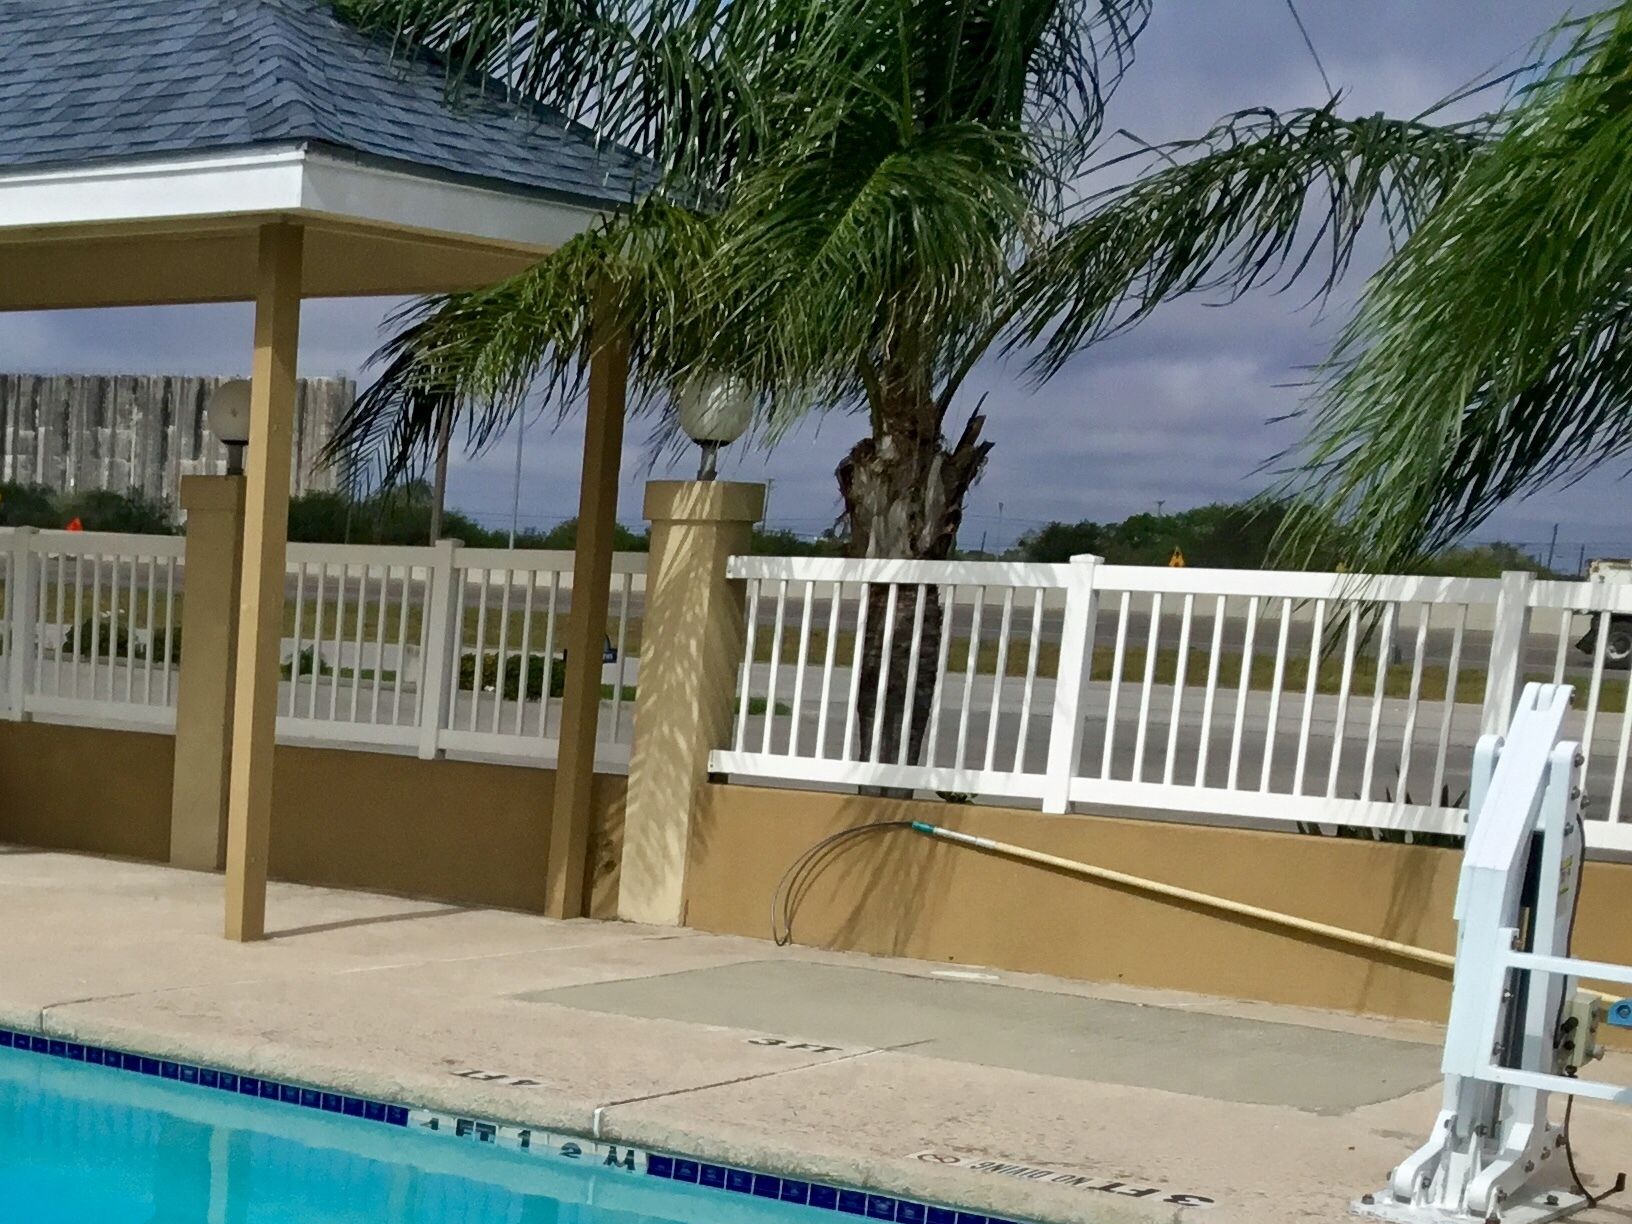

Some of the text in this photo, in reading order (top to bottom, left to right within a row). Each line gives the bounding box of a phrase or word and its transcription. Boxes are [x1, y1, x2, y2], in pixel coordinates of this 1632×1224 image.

[970, 1160, 1056, 1180] DIVING
[1051, 1174, 1095, 1187] NO
[1163, 1194, 1215, 1207] 3
